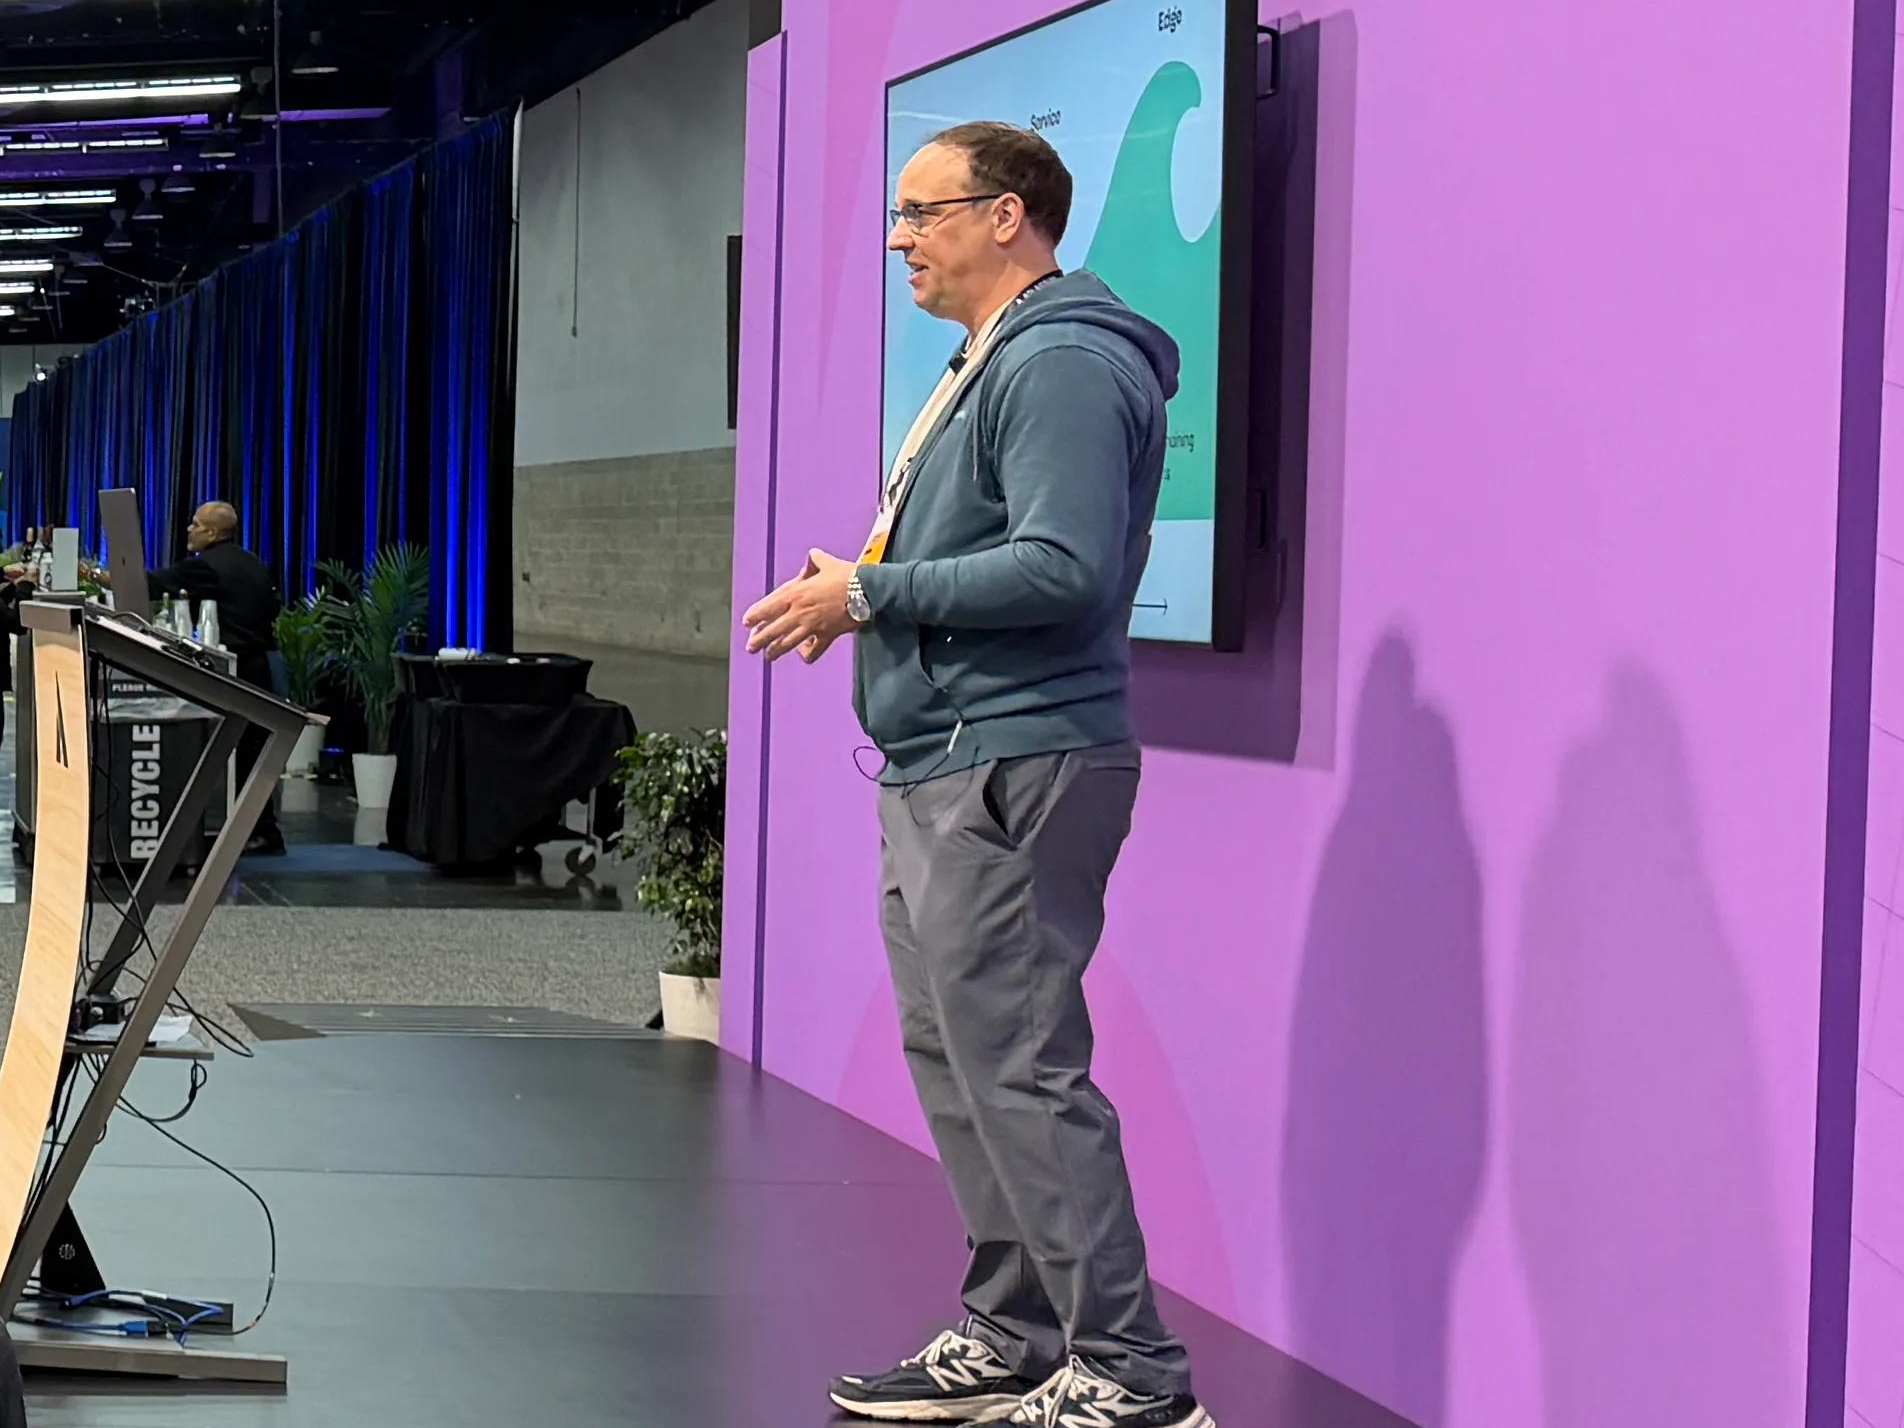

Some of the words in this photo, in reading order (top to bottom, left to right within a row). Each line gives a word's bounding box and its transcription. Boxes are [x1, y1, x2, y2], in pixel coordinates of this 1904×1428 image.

[1158, 6, 1182, 32] Edge
[1030, 108, 1061, 132] Service
[130, 724, 161, 859] RECYCLE
